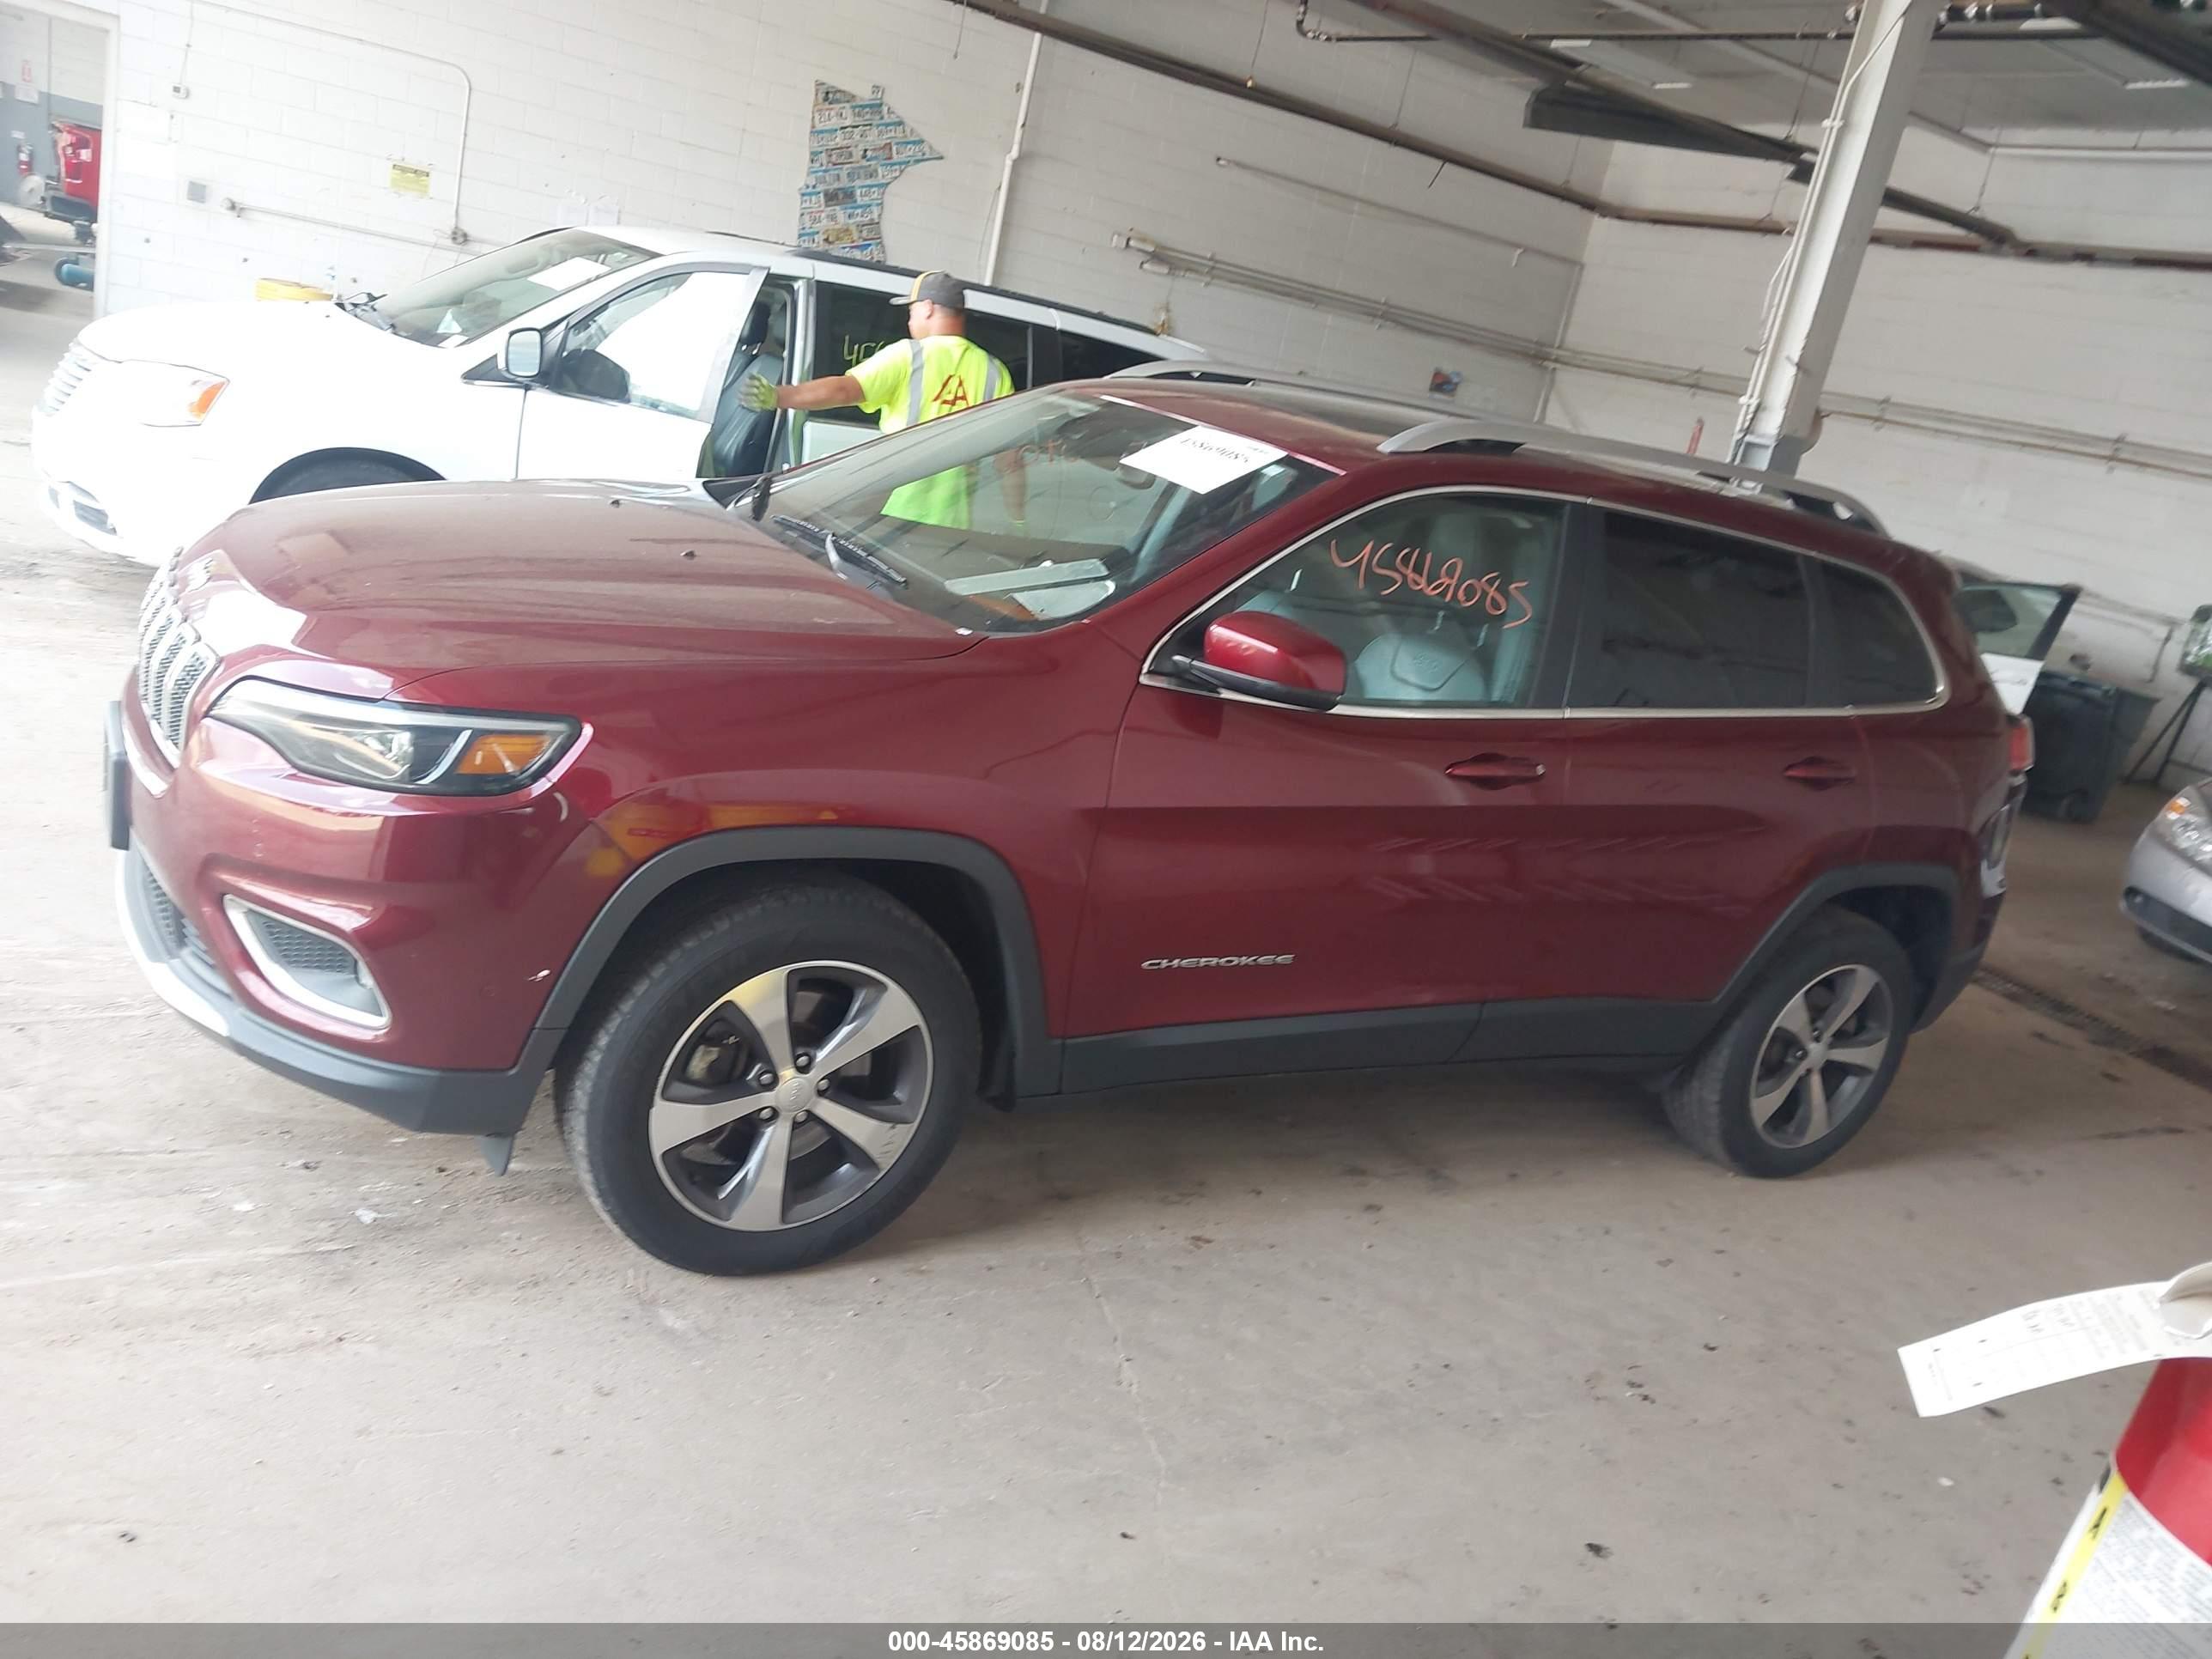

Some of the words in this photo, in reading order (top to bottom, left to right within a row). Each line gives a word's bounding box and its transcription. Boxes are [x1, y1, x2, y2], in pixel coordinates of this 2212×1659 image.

[843, 334, 885, 367] 45
[1331, 538, 1533, 629] 45869085
[1140, 954, 1296, 969] CHEROKEE
